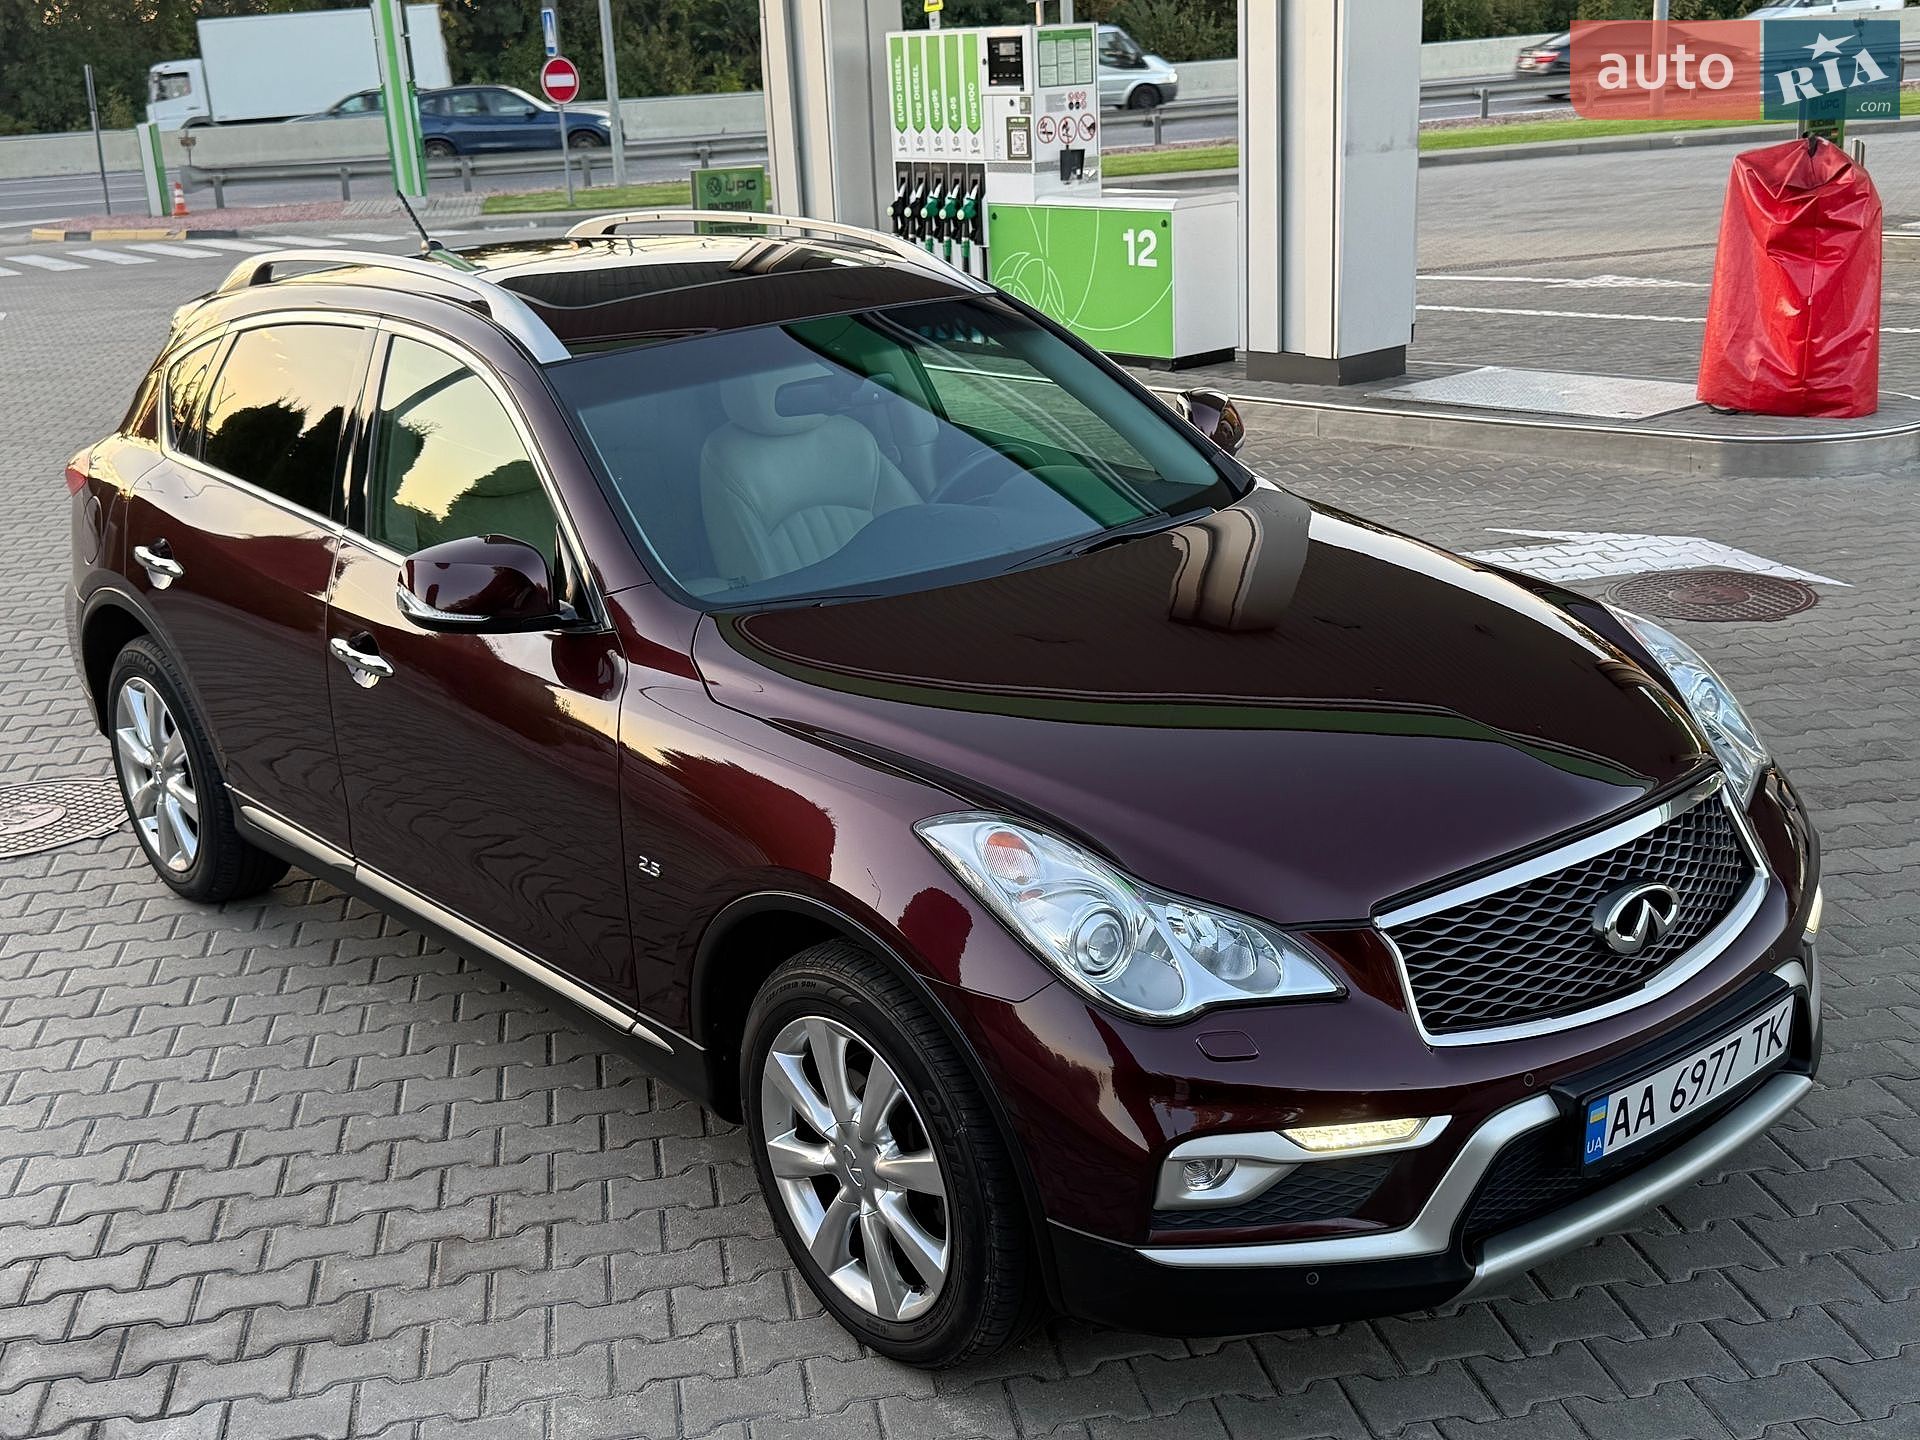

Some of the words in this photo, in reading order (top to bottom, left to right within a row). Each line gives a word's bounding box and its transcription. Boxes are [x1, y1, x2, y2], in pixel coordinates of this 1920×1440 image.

[894, 55, 903, 92] DIESEL
[912, 63, 921, 100] DIESEL
[895, 93, 905, 122] EURO
[949, 96, 959, 122] A-95
[725, 179, 757, 192] UPG
[1122, 228, 1158, 268] 12
[1608, 1083, 1656, 1147] AA
[1669, 1036, 1743, 1114] 6977
[1752, 1006, 1789, 1066] TK
[1586, 1136, 1603, 1155] UA
